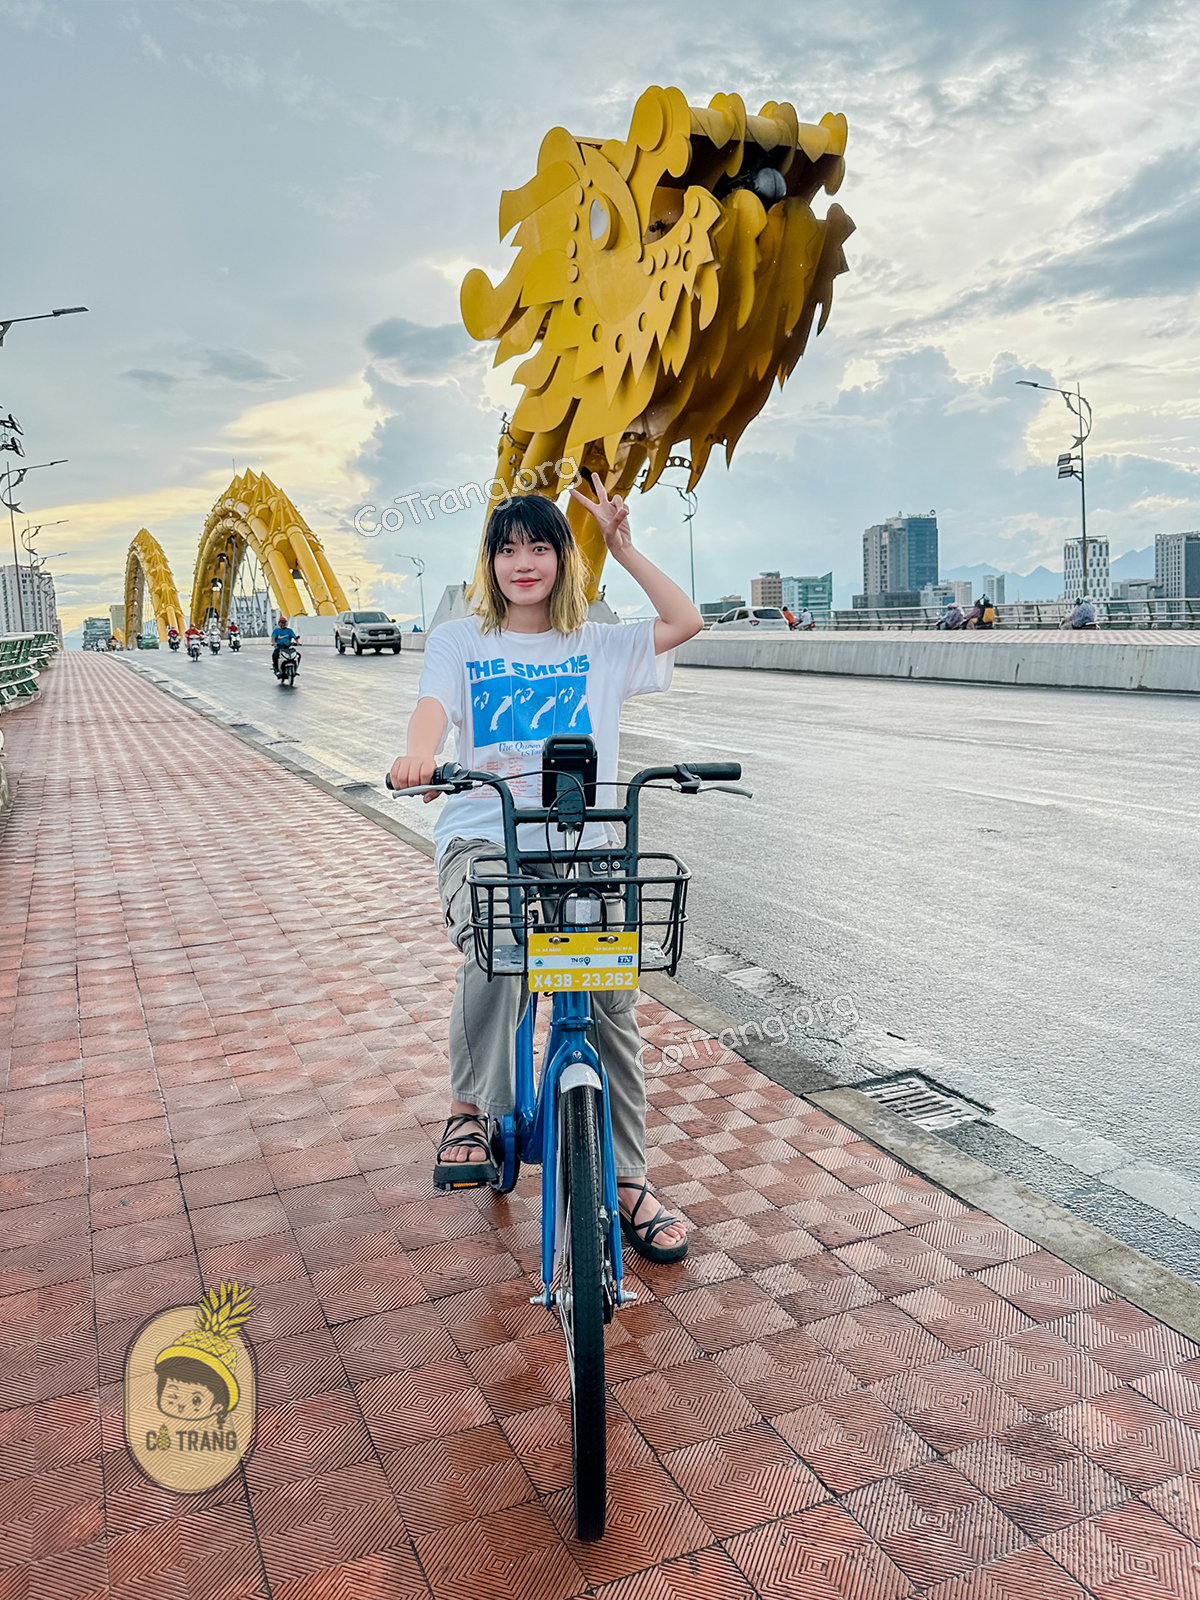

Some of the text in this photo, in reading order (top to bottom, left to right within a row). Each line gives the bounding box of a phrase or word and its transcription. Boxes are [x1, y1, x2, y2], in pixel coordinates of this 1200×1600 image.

[466, 654, 590, 681] THE SMITHS
[498, 742, 514, 753] The
